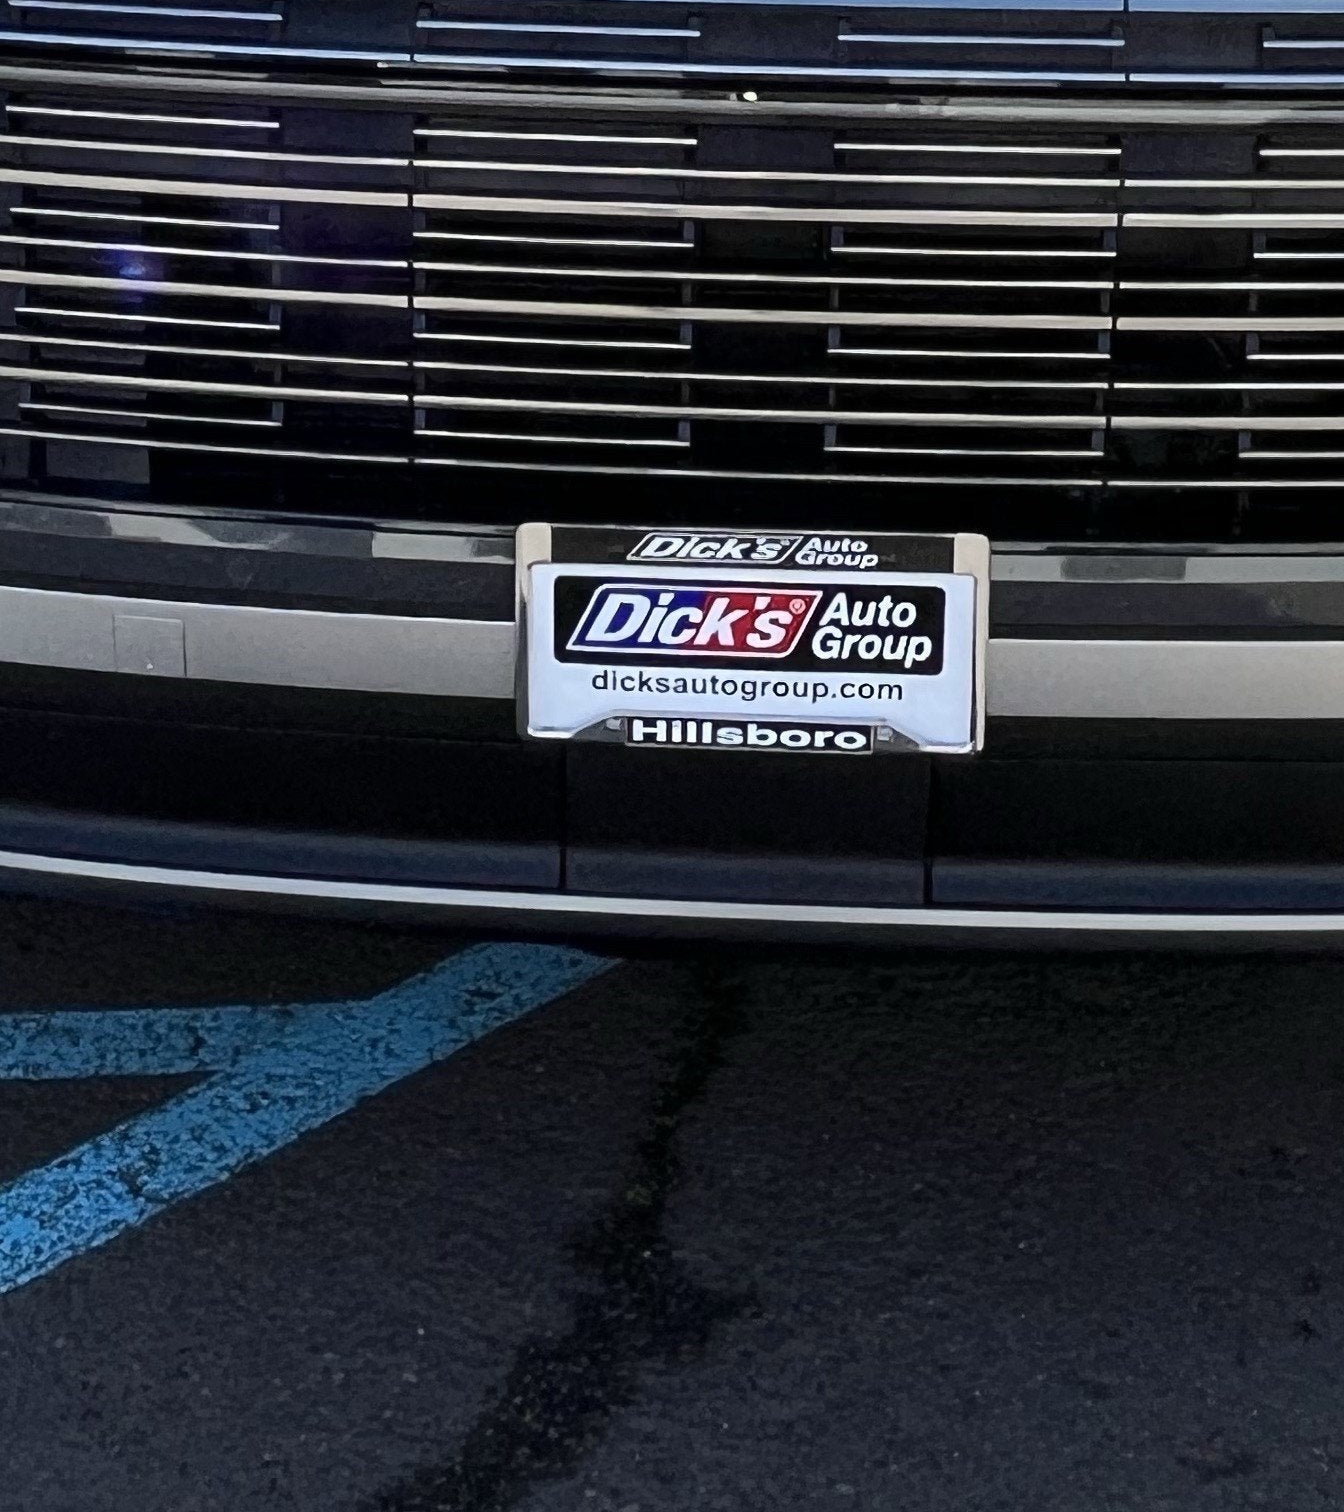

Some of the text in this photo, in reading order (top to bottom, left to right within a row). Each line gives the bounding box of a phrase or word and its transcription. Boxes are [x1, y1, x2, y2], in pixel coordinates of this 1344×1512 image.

[640, 536, 783, 560] Dick's
[794, 551, 879, 569] Group
[804, 537, 868, 553] Auto
[584, 592, 794, 649] Dick's
[818, 592, 917, 628] Auto
[811, 628, 932, 668] Group
[591, 669, 904, 704] dicksautogroup.com
[631, 719, 867, 750] Hillsboro
